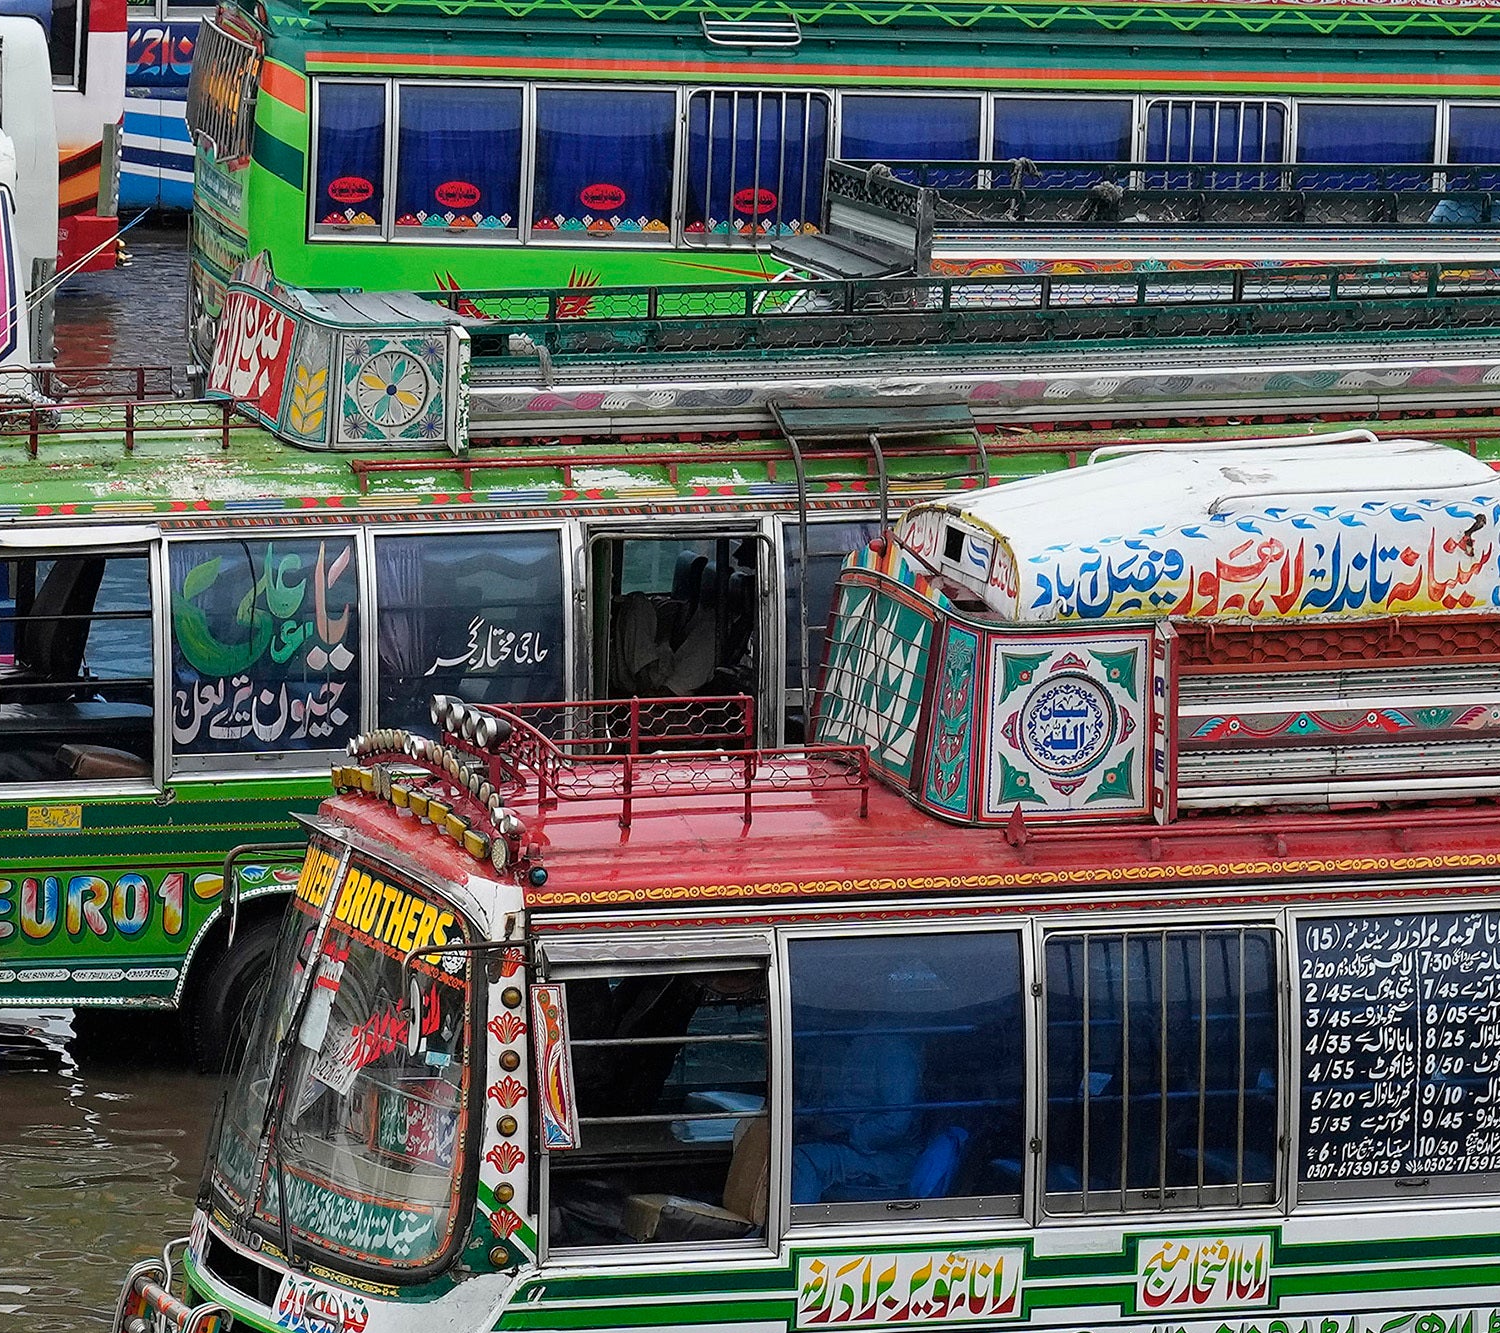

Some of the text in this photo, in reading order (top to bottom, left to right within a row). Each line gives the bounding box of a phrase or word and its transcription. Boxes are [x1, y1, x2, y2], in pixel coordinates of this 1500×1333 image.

[1168, 537, 1304, 617] لاہور
[335, 867, 455, 965] BROTHERS
[1301, 957, 1336, 979] 2/20
[1304, 982, 1353, 1003] 2/45
[1423, 974, 1460, 999] 7/45
[1305, 1008, 1352, 1028] 3/45
[1426, 1004, 1468, 1026] 8/05
[1305, 1030, 1352, 1055] 4/35
[1425, 1026, 1466, 1049] 8/25
[1307, 1060, 1355, 1082] 4/55
[1425, 1053, 1464, 1075] 8/50
[1310, 1089, 1355, 1111] 5/20
[1422, 1083, 1463, 1106] 9/10
[1309, 1115, 1352, 1134] 5/35
[1422, 1109, 1465, 1130] 9/45
[1419, 1136, 1459, 1157] 10/30
[1237, 1240, 1267, 1301] رانا
[967, 1255, 1020, 1316] رانا
